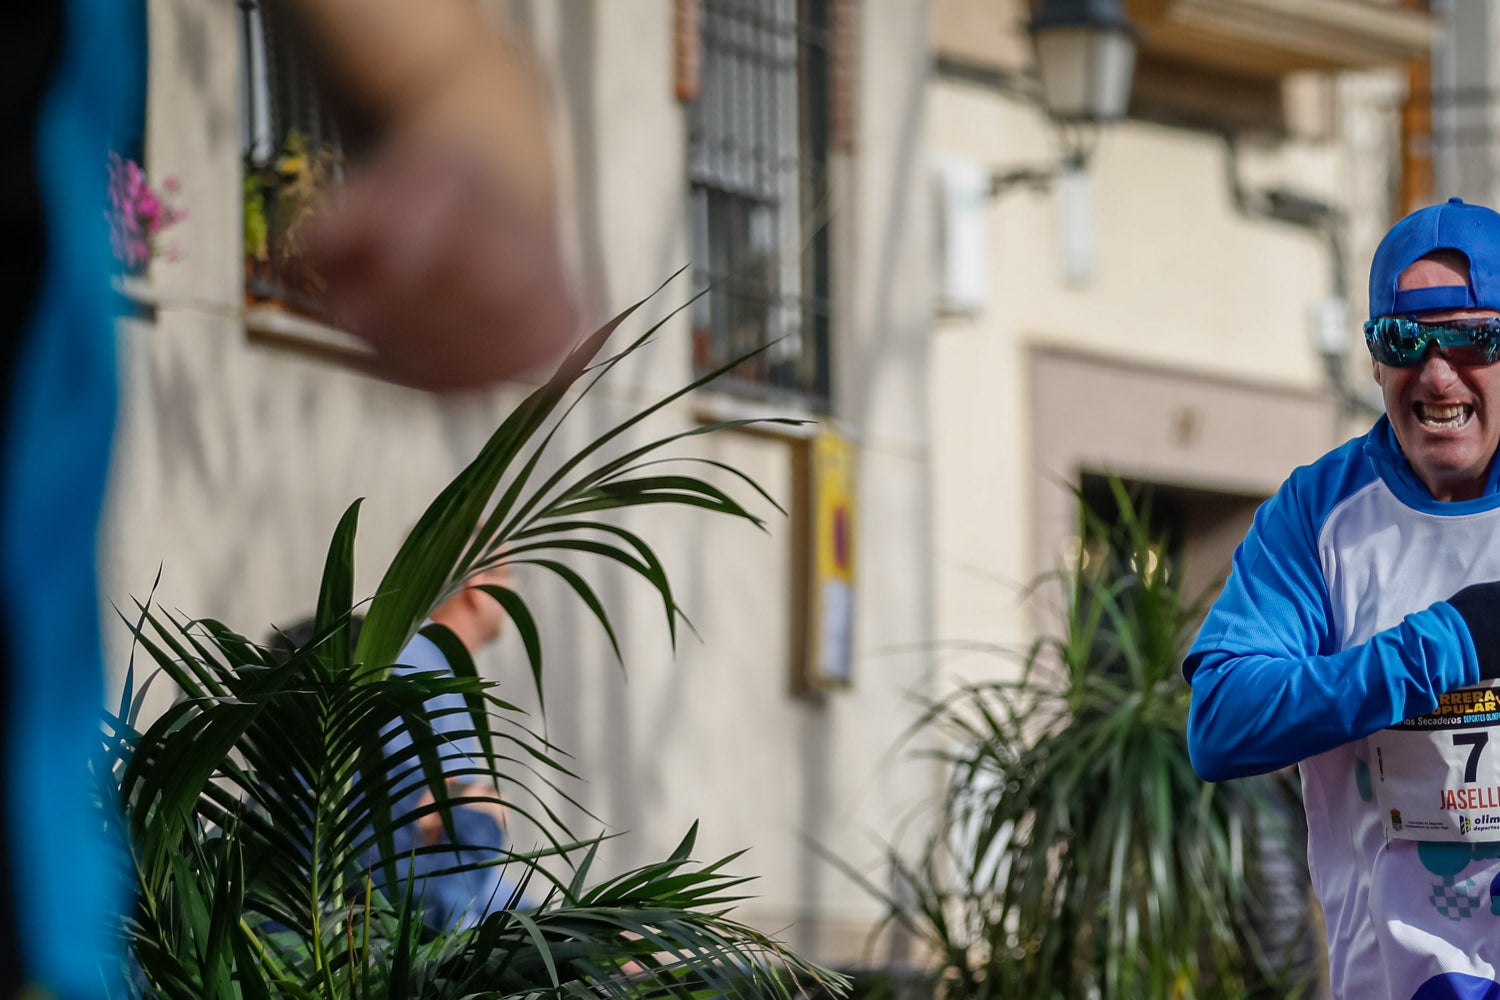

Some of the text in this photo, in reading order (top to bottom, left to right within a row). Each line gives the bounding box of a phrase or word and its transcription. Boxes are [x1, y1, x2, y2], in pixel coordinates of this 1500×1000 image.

[1439, 690, 1496, 705] RRERA
[1417, 715, 1462, 726] Secaderos
[1452, 731, 1489, 783] 7
